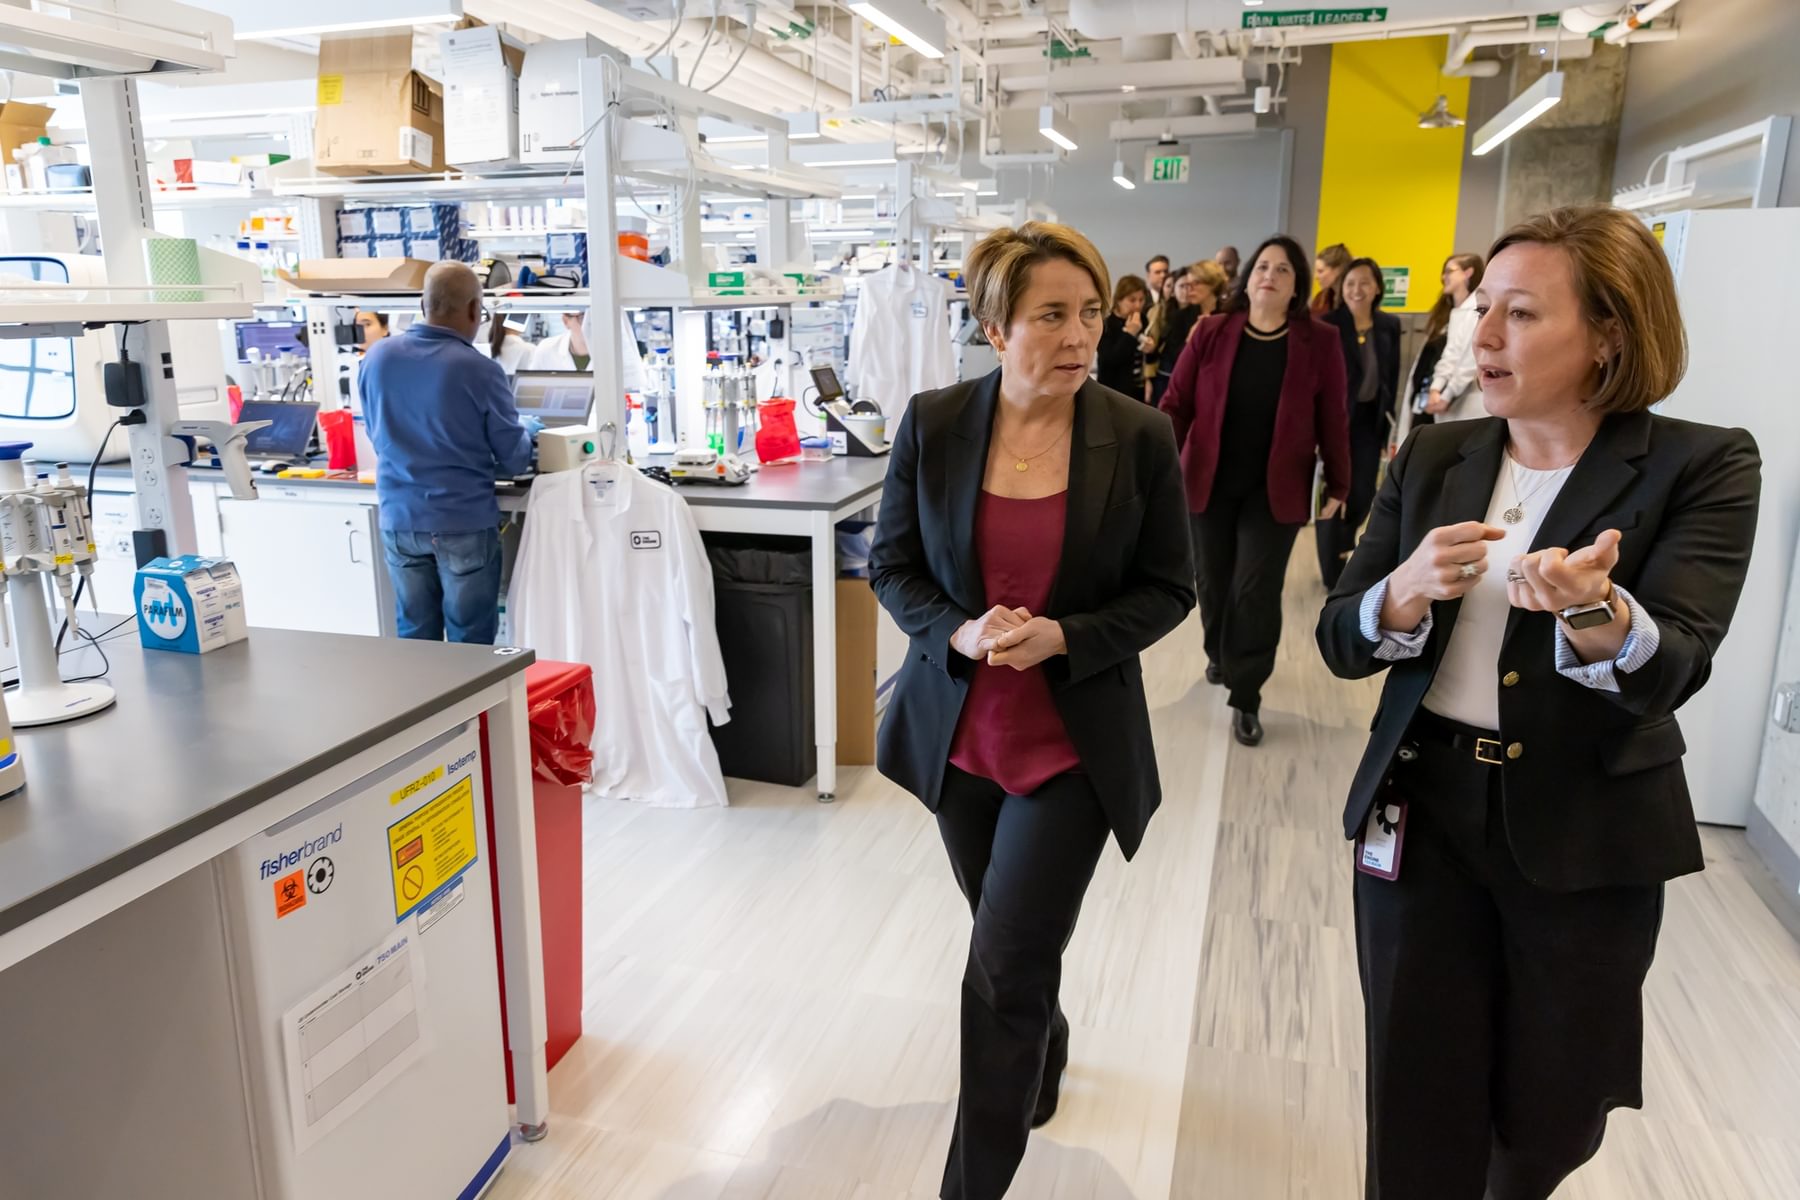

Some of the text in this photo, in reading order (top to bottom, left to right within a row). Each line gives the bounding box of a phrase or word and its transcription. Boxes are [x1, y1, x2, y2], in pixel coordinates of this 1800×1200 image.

[1277, 12, 1314, 25] WATER
[1318, 12, 1364, 24] LEADER
[1153, 157, 1182, 180] EXIT
[143, 604, 184, 617] PARAFILM
[447, 750, 477, 775] Isotemp
[260, 822, 342, 880] fisherbrand
